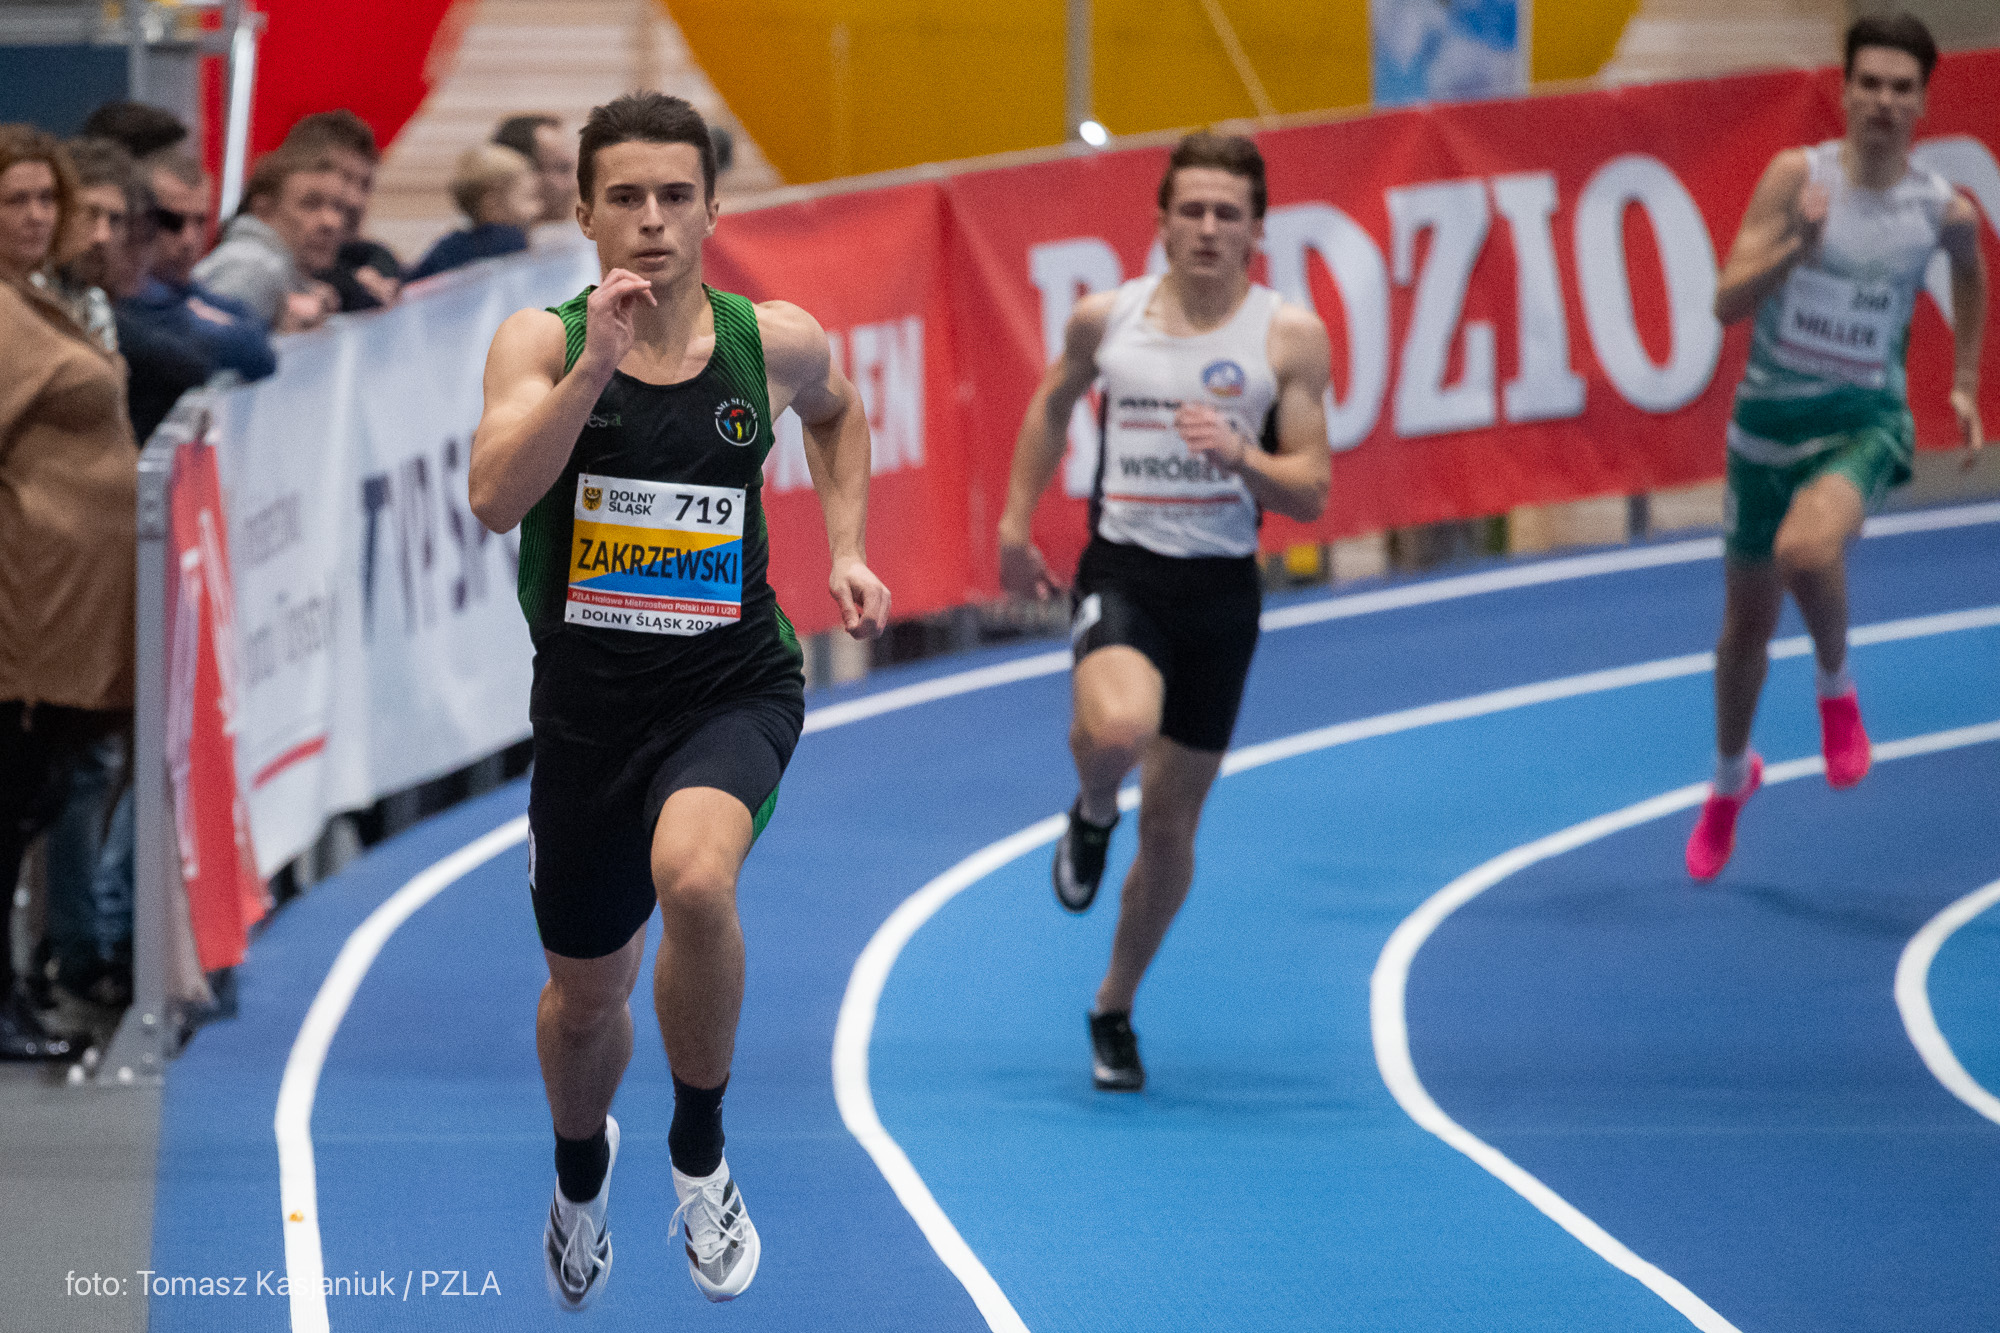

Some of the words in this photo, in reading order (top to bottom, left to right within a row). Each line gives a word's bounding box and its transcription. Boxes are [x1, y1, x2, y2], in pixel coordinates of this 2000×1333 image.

[609, 489, 656, 504] DOLNY
[675, 493, 733, 525] 719
[577, 537, 738, 585] ZAKRZEWSKI
[572, 591, 590, 601] PZLA
[592, 594, 624, 606] Halowe
[624, 598, 674, 610] Mistrzostwa
[675, 602, 699, 612] Polski
[721, 607, 737, 615] U20
[582, 609, 632, 625] DOLNY
[636, 611, 682, 632] ŚLĄSK
